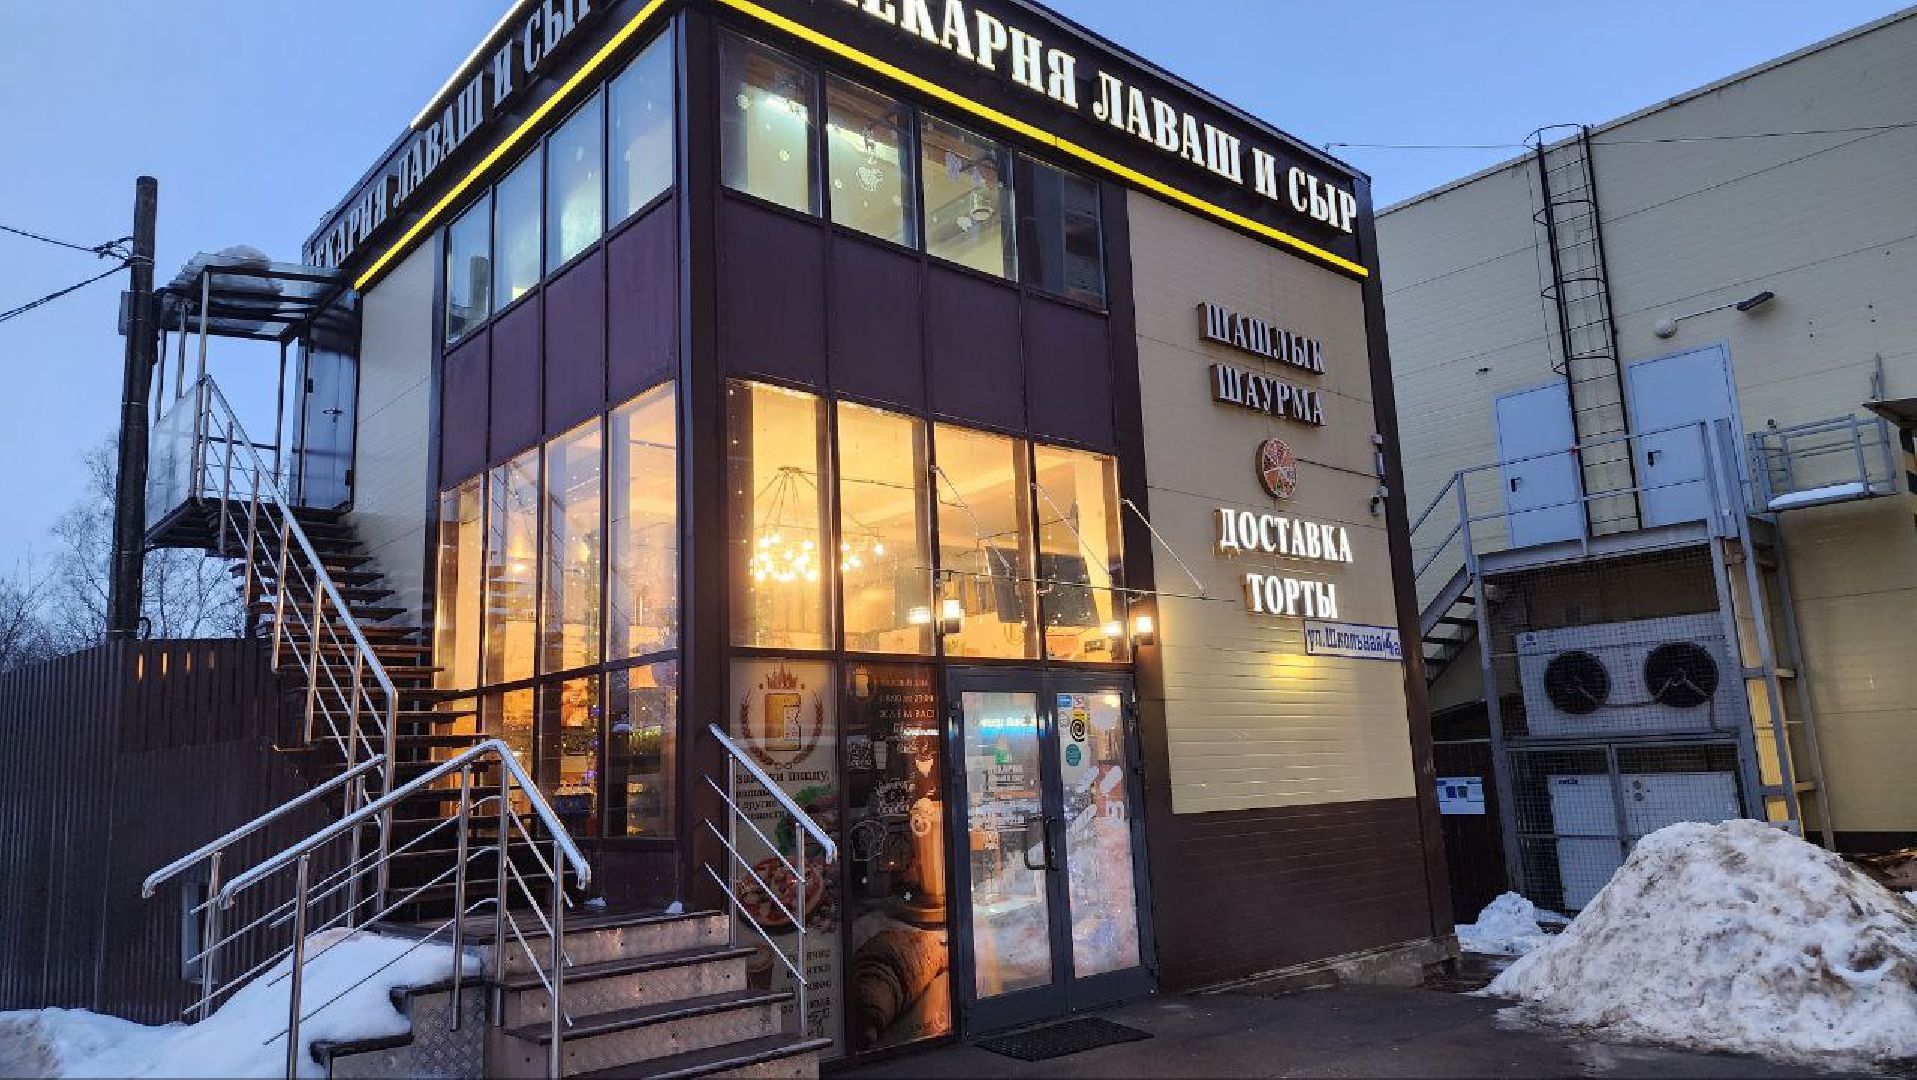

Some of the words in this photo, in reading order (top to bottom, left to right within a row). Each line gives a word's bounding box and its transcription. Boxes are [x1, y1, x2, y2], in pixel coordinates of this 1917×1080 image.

[392, 70, 483, 208] ЛАВАШ
[493, 37, 513, 109] И
[1093, 70, 1243, 184] ЛАВАШ
[1252, 147, 1278, 201] И
[1289, 166, 1358, 234] СЫР
[1203, 303, 1326, 375] ШАШЛЫК
[1213, 364, 1326, 426] ШАУРМА
[1218, 507, 1353, 564] ДОСТАВКА
[1245, 573, 1338, 619] ТОРТЫ
